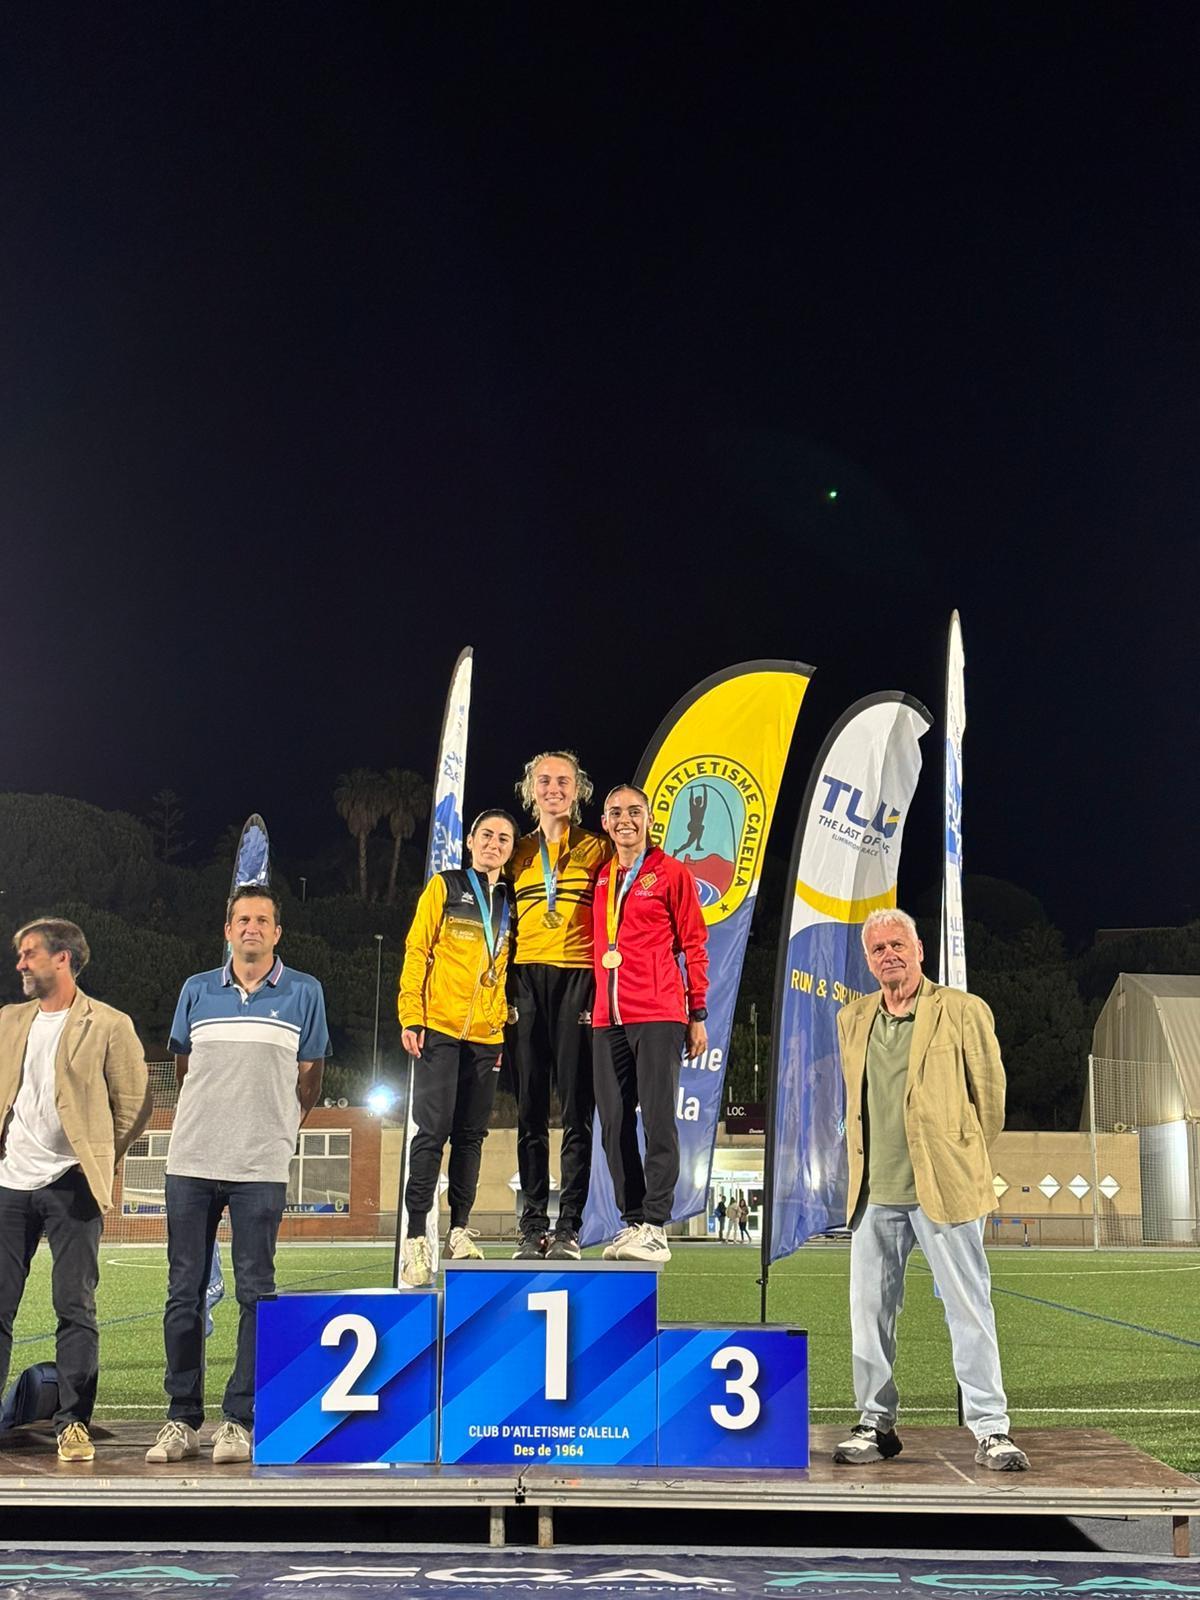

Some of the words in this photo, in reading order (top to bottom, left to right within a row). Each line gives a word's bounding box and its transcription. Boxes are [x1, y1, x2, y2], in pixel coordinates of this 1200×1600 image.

[657, 761, 758, 813] D'ATLETISME
[734, 813, 761, 888] CALELLA
[818, 815, 839, 831] THE
[839, 823, 862, 841] LAST
[862, 834, 883, 847] OF
[791, 968, 814, 995] RUN
[816, 979, 828, 998] &
[727, 1106, 747, 1117] LOC.
[527, 1289, 569, 1401] 1
[320, 1313, 379, 1412] 2
[710, 1346, 761, 1431] 3
[468, 1425, 499, 1438] CLUB
[502, 1425, 576, 1438] D'ATLETISME
[579, 1426, 630, 1439] CALELLA
[514, 1444, 535, 1456] Des
[537, 1444, 551, 1456] de
[555, 1445, 584, 1457] 1964
